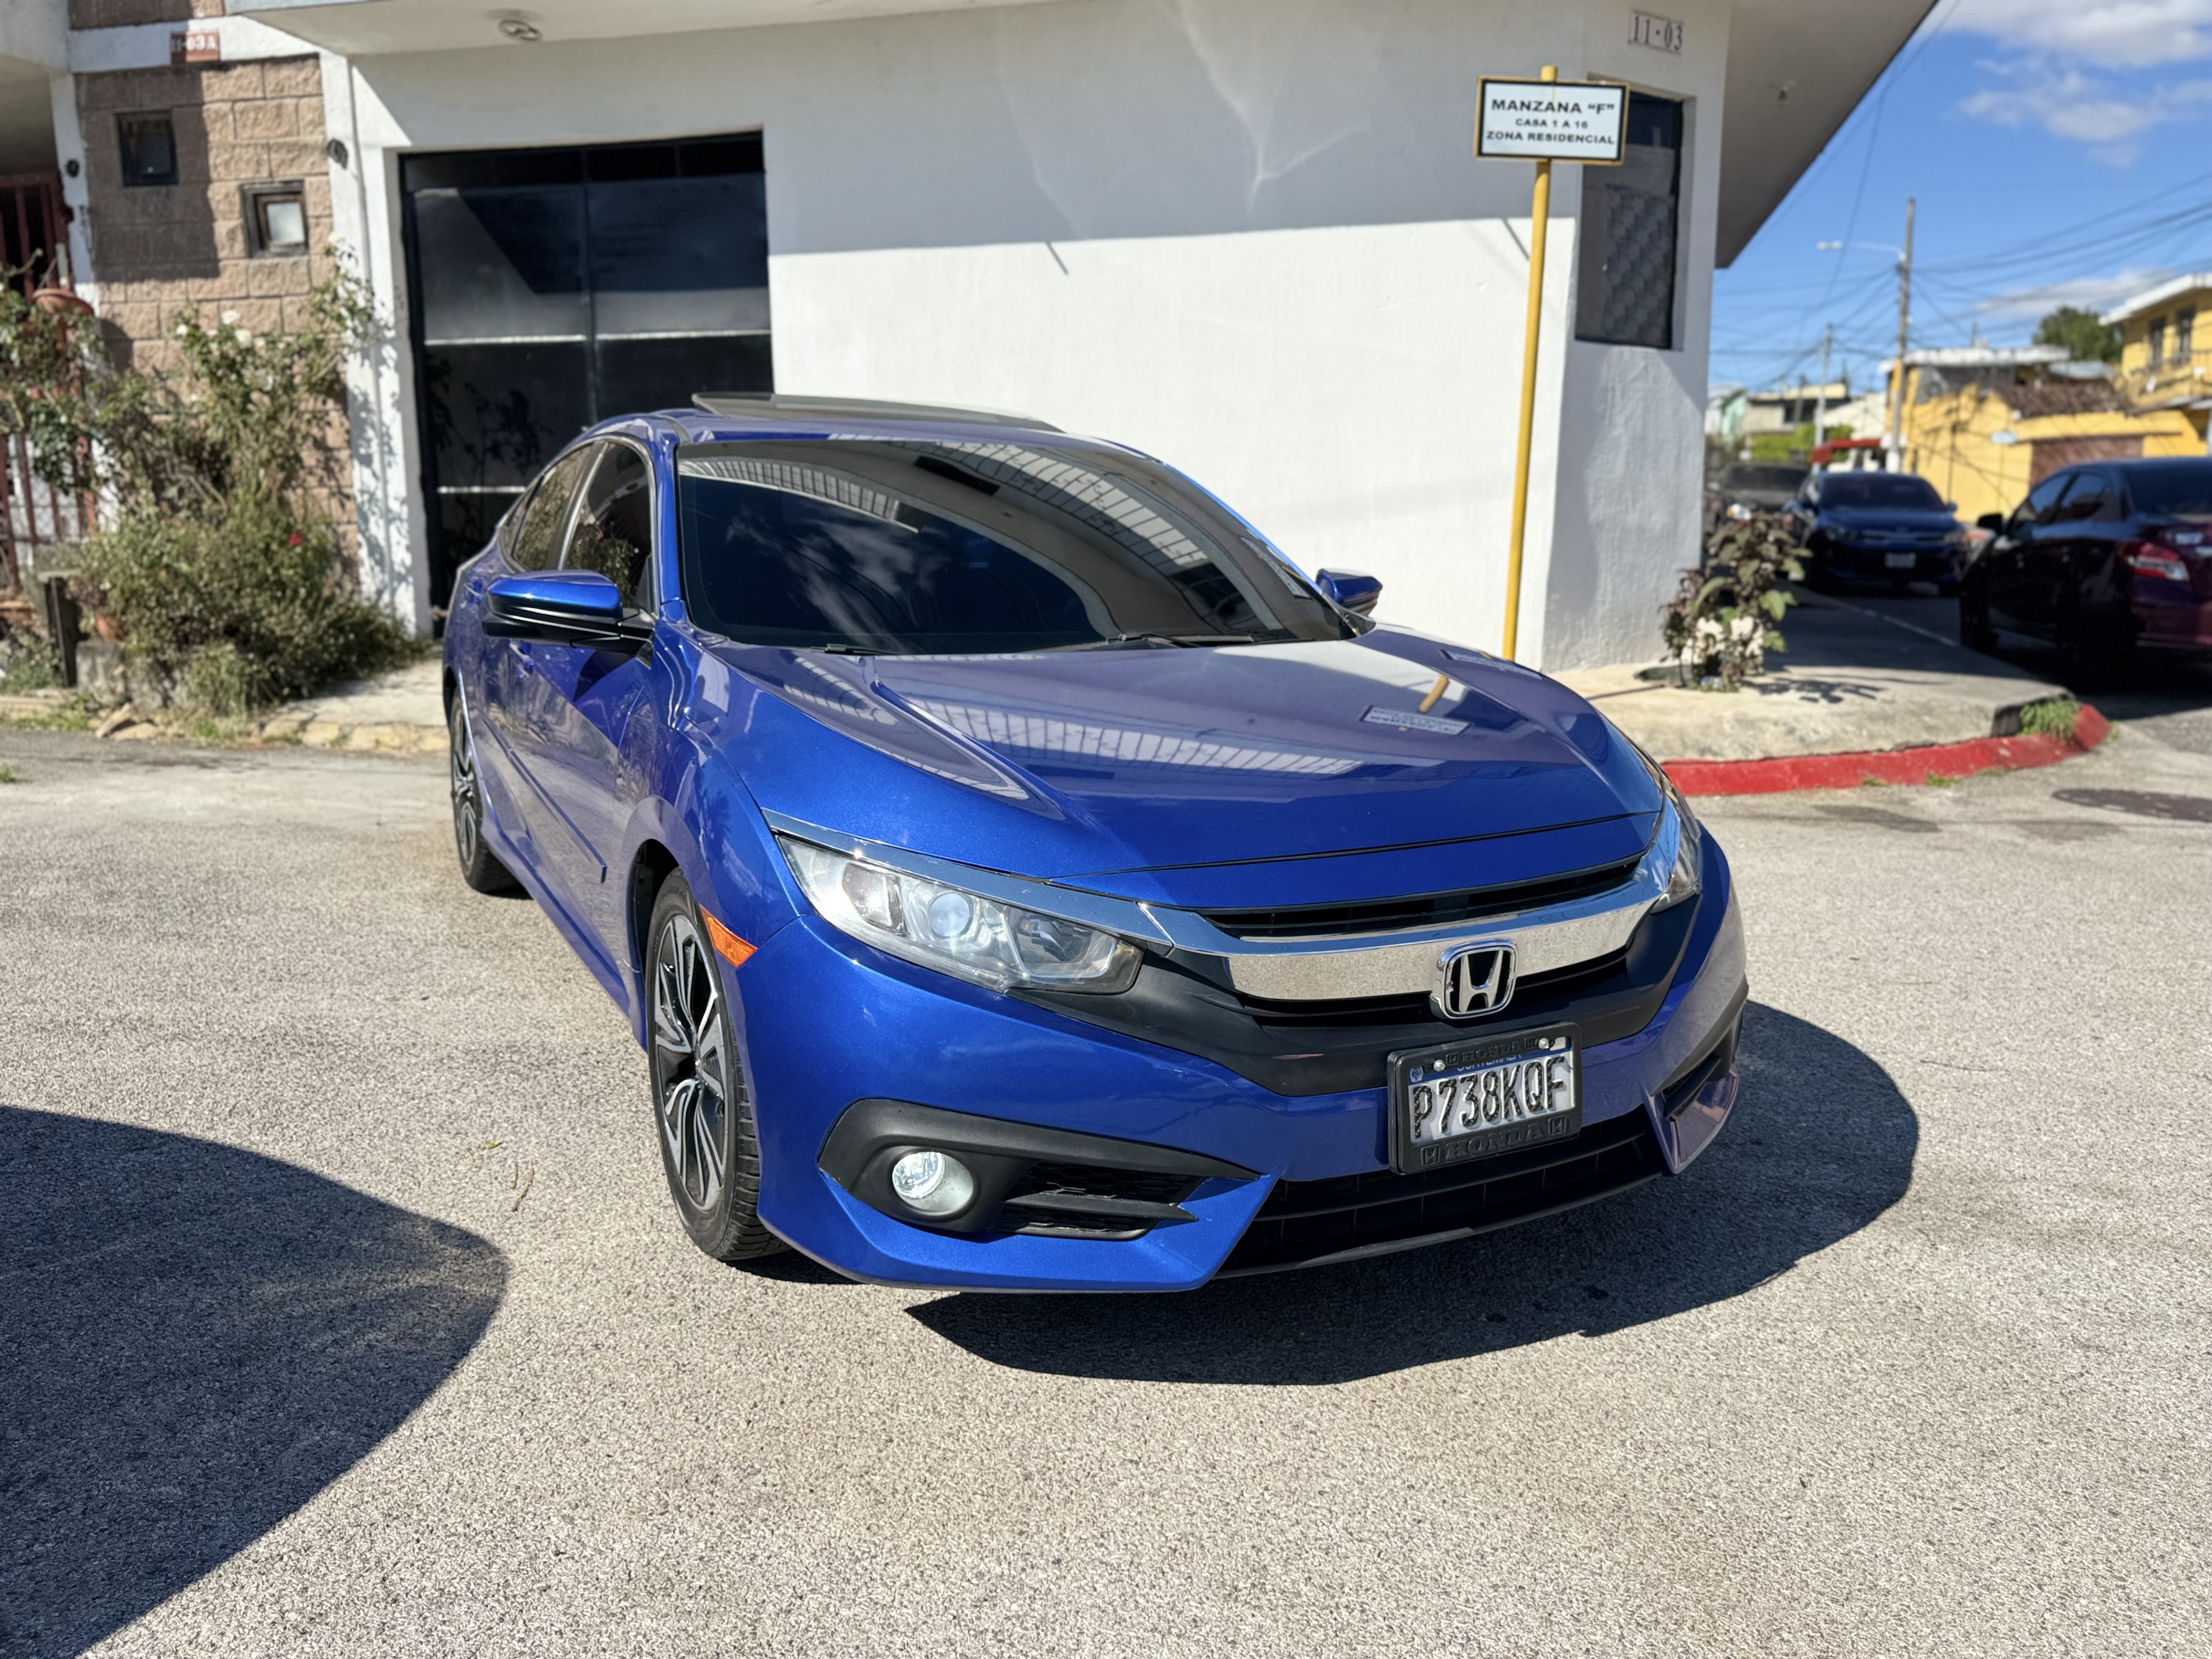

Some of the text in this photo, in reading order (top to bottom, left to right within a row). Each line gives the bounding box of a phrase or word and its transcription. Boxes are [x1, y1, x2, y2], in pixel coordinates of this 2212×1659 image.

[1491, 99, 1582, 114] MANZANA
[1515, 118, 1548, 127] CASA
[1552, 120, 1558, 128] 1
[1486, 131, 1615, 144] ZONA RESIDENCIAL
[1462, 1041, 1521, 1063] HONDA
[1412, 1056, 1565, 1139] P738KQF
[1446, 1123, 1544, 1159] HONDA
